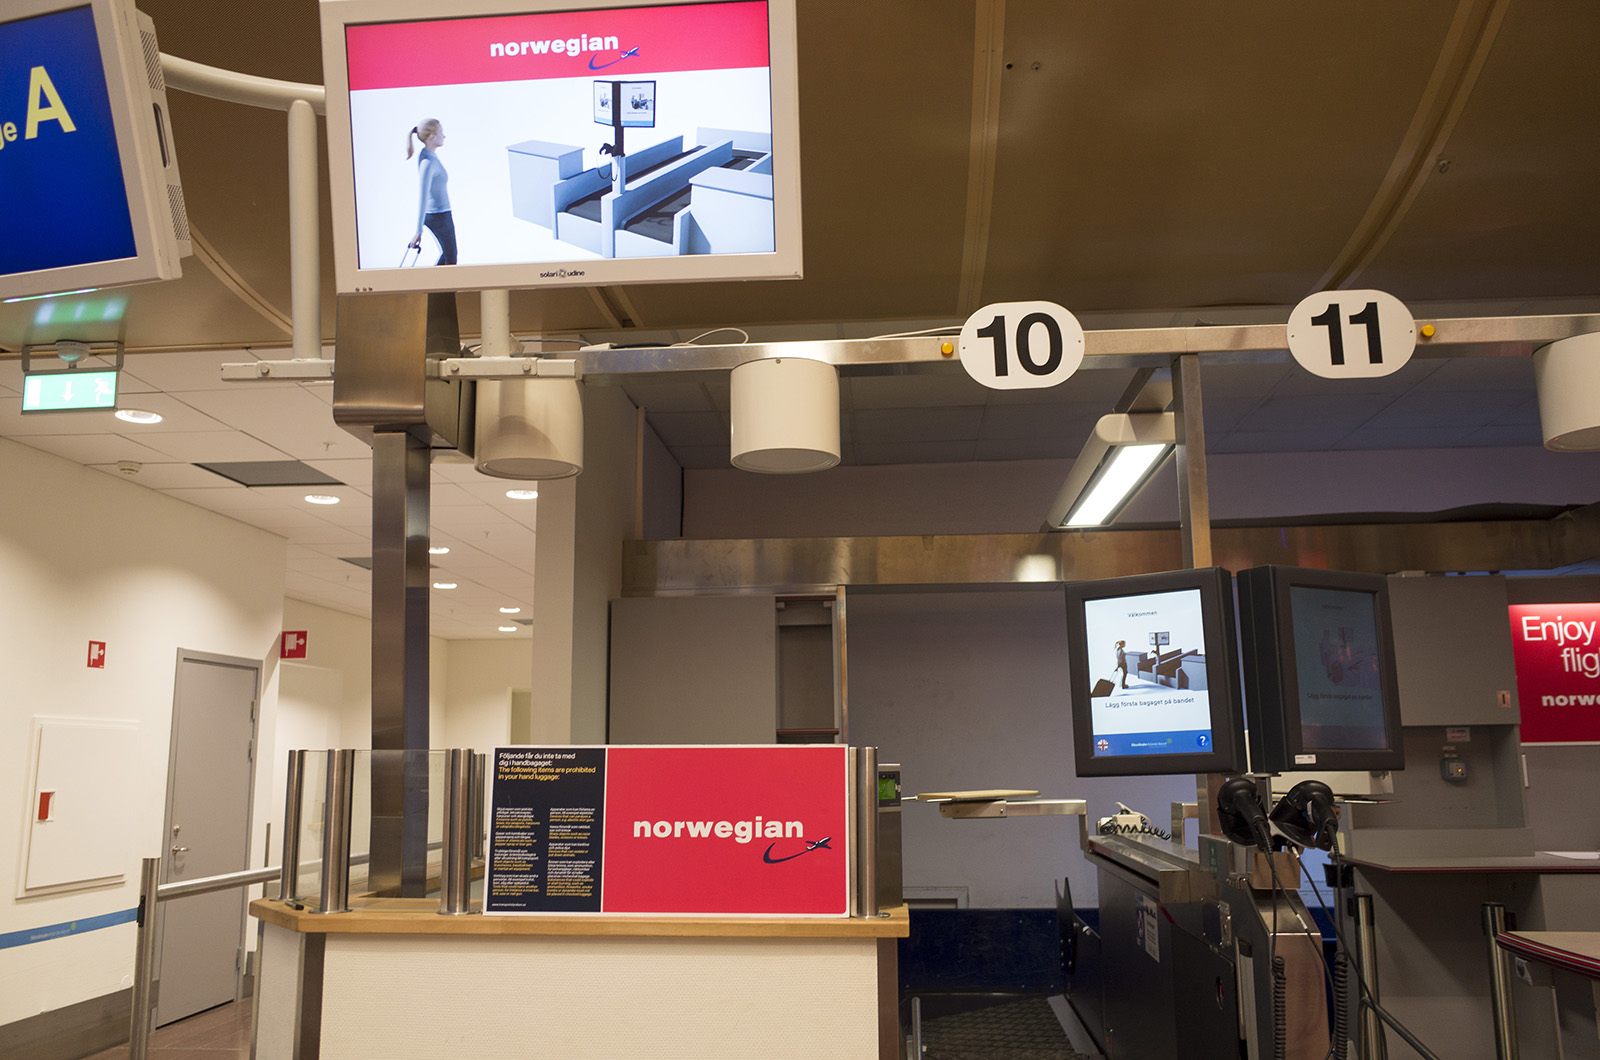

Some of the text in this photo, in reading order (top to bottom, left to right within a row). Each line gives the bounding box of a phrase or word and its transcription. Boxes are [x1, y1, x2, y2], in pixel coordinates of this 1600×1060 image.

[490, 34, 619, 57] norwegian
[0, 65, 77, 151] e A
[977, 312, 1063, 377] 10
[1310, 301, 1383, 365] 11
[1521, 615, 1597, 646] Enjoy
[1560, 646, 1600, 679] flig
[499, 752, 525, 760] Följande
[511, 766, 537, 774] following
[565, 766, 596, 774] prohibited
[633, 816, 804, 843] norwegian
